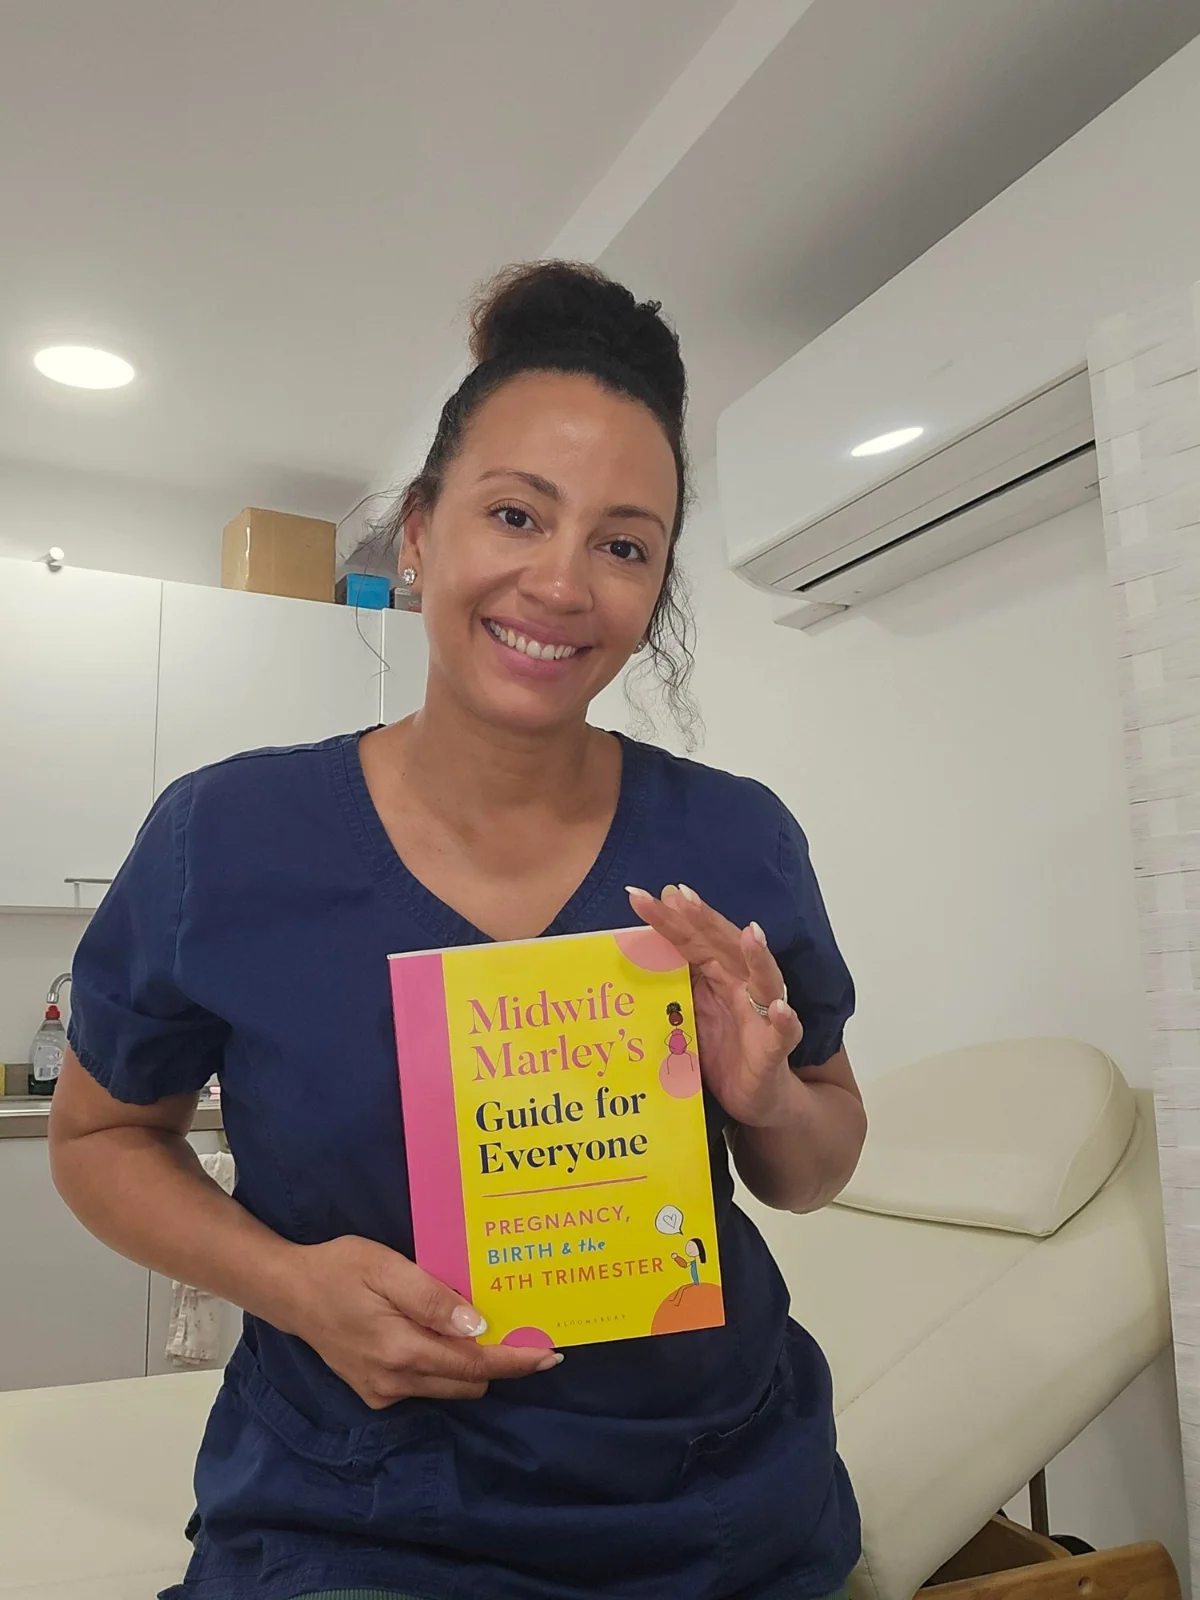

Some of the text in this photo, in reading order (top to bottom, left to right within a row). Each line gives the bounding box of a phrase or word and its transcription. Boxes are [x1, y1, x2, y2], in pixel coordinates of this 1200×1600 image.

[468, 981, 635, 1034] Midwife
[475, 1086, 646, 1132] Guide for
[478, 1134, 648, 1174] Everyone
[485, 1205, 631, 1237] PREGNANCY,
[487, 1238, 605, 1265] BIRTH & the
[490, 1257, 664, 1291] 4TH TRIMESTER
[556, 1314, 626, 1328] BLOOMSBURY
